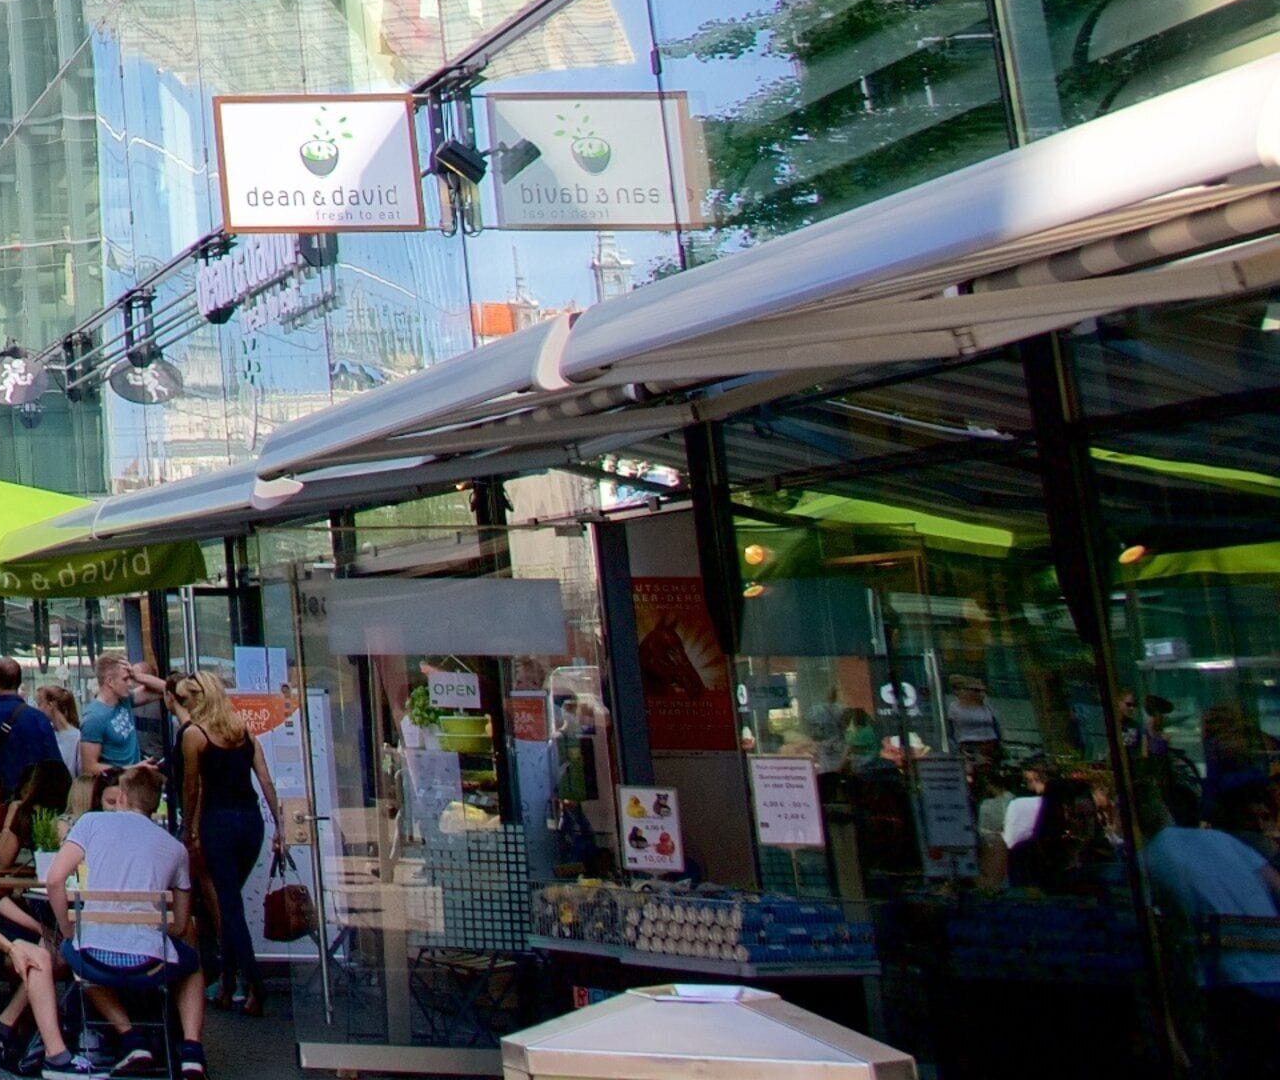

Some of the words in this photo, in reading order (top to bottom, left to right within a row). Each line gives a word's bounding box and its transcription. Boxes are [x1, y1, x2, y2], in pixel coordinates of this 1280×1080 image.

[246, 186, 306, 207] dean
[312, 190, 326, 207] &
[331, 184, 399, 206] david
[315, 209, 353, 220] fresh
[359, 210, 372, 220] to
[378, 210, 401, 220] eat
[57, 546, 152, 588] david
[432, 682, 477, 697] OPEN
